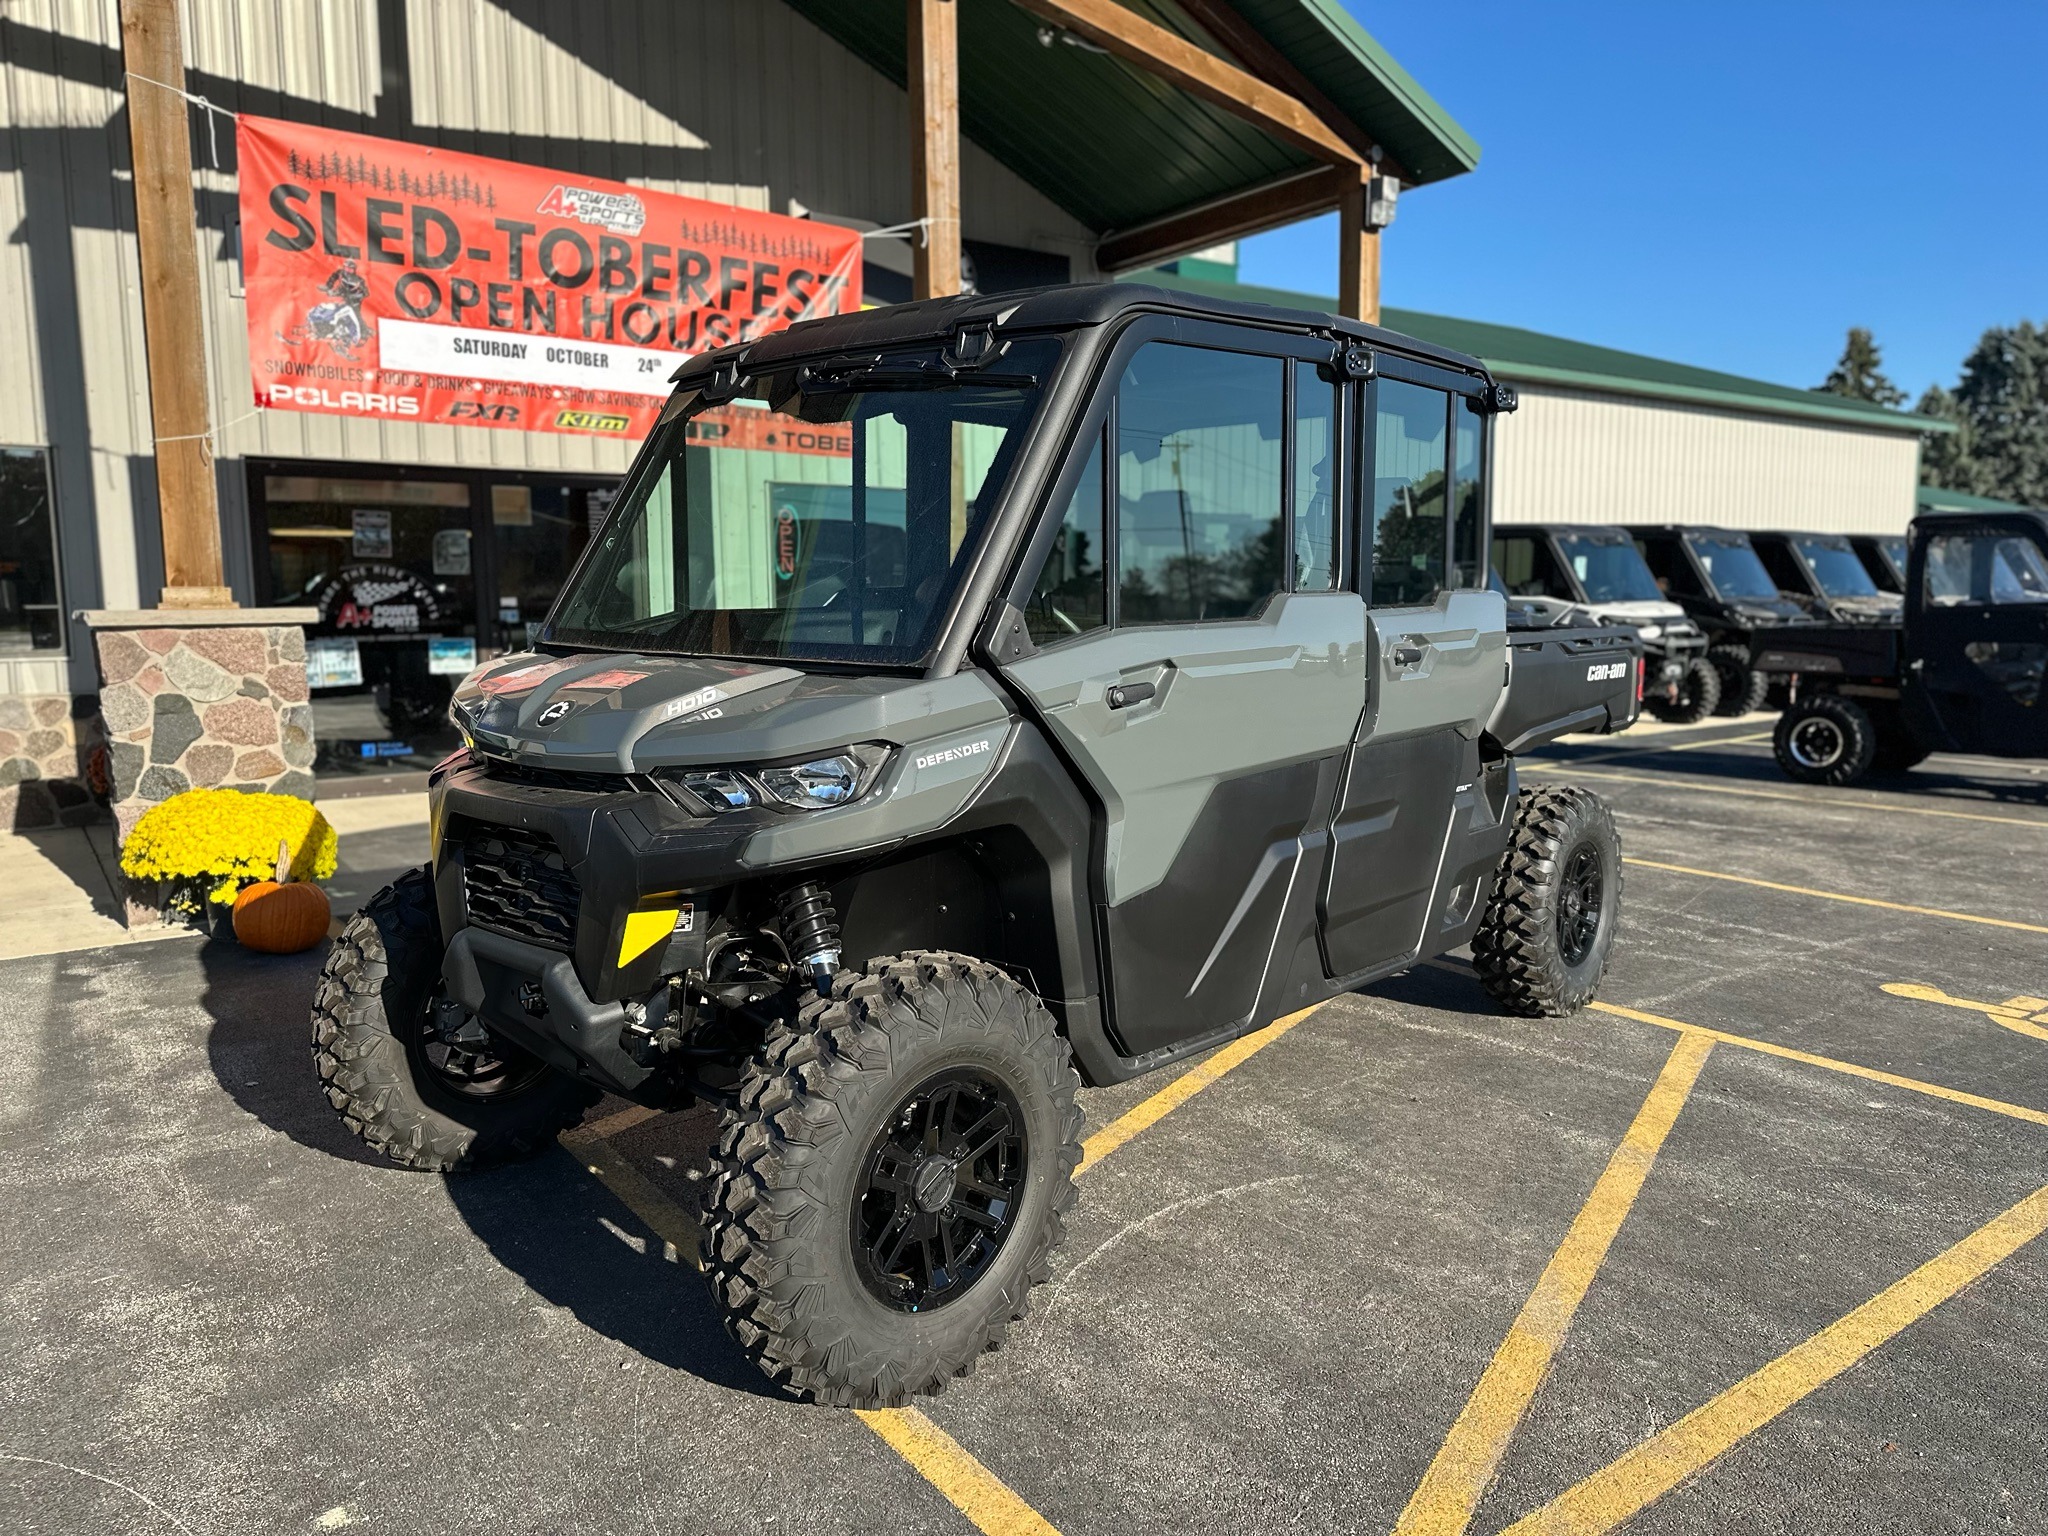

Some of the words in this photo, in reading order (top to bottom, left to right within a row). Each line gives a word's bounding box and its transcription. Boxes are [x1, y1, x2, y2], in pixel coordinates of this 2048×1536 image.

[265, 183, 849, 321] SLED-TOBERFEST
[394, 271, 557, 334] OPEN
[453, 337, 528, 360] SATURDAY
[546, 347, 609, 368] OCTOBER
[638, 357, 662, 373] 24th
[265, 360, 364, 383] SNOWMOBILES
[376, 370, 409, 387] FOOD
[415, 374, 423, 388] &
[427, 375, 473, 393] DRINKS
[483, 381, 552, 400] GIVEAWAYS
[562, 387, 595, 404] SHOW
[599, 391, 647, 409] SAVINGS
[268, 384, 421, 416] POLARIS
[449, 401, 520, 423] FXR
[781, 431, 850, 452] TOBE
[778, 508, 794, 574] OPEN
[372, 616, 420, 629] SPORTS
[373, 604, 418, 617] POWER
[1586, 662, 1627, 681] can-am
[667, 689, 717, 716] HD10
[916, 740, 990, 770] DEFENDER
